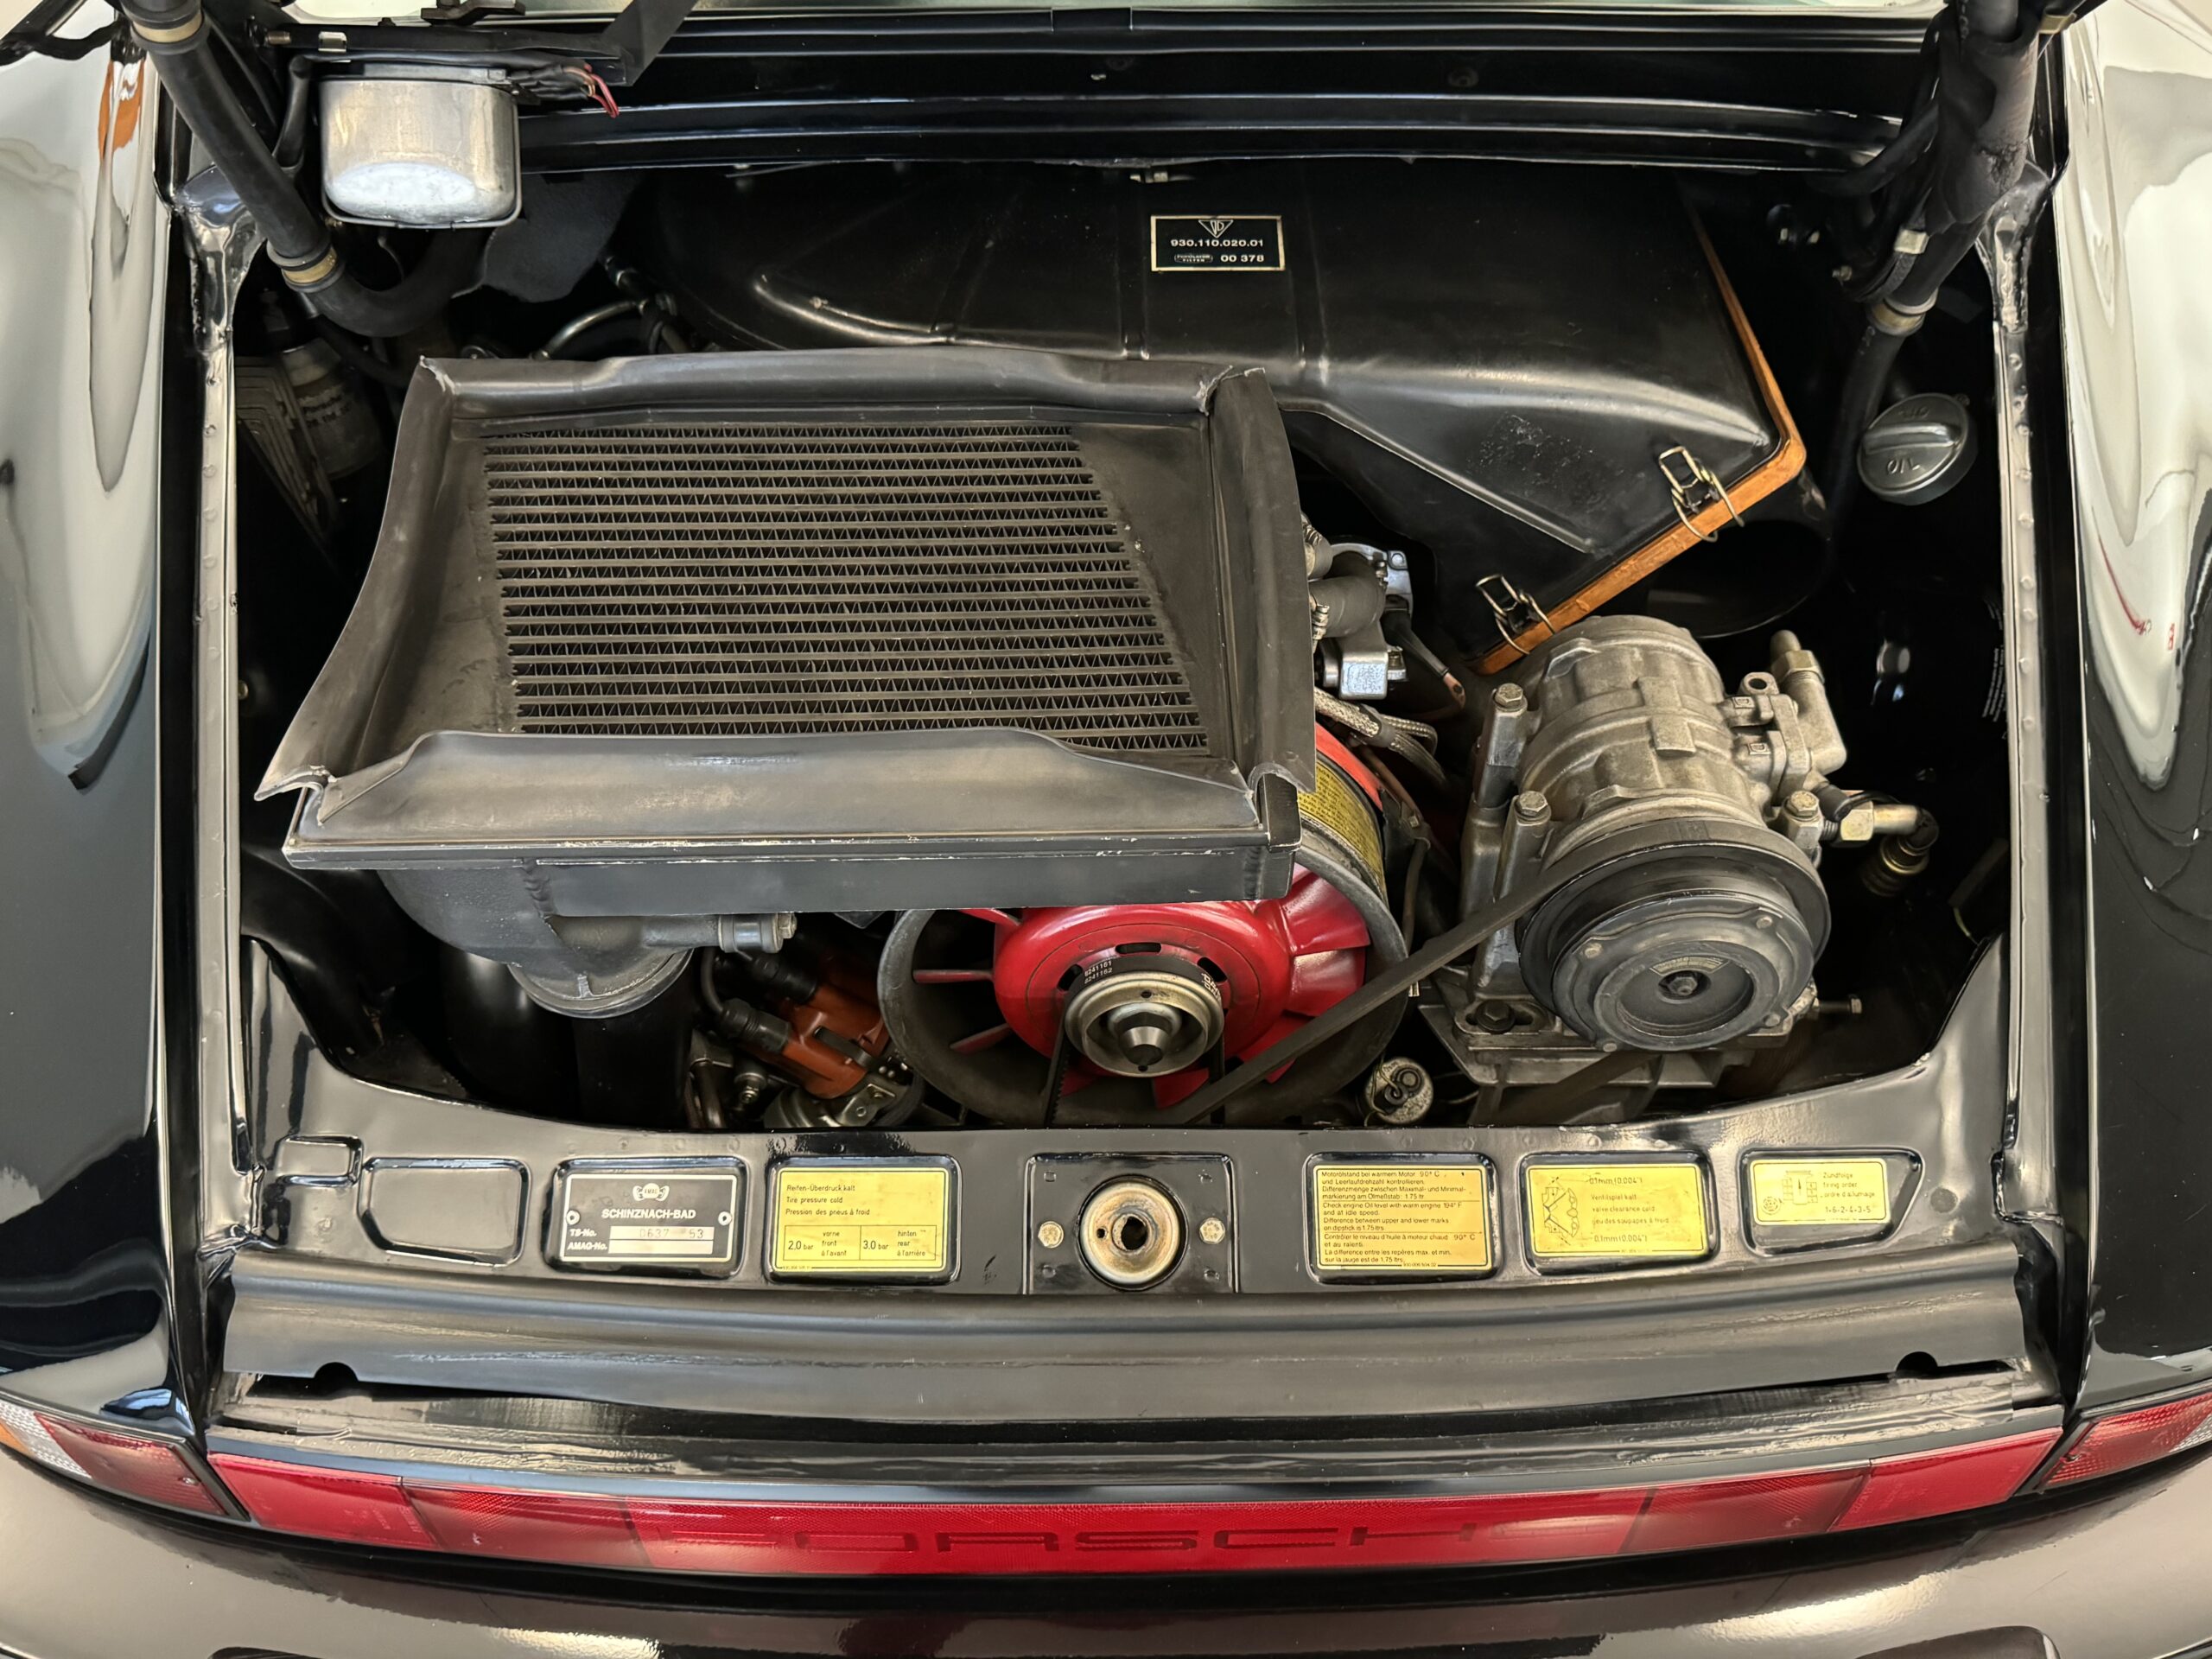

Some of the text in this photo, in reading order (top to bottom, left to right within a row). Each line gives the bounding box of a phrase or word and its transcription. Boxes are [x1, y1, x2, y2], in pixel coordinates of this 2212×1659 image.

[1170, 238, 1263, 247] 930.110.020.01
[1220, 254, 1265, 263] 00 378
[601, 1208, 696, 1219] SCHINZNACH-BAD
[567, 1241, 608, 1250] AMAG-No.
